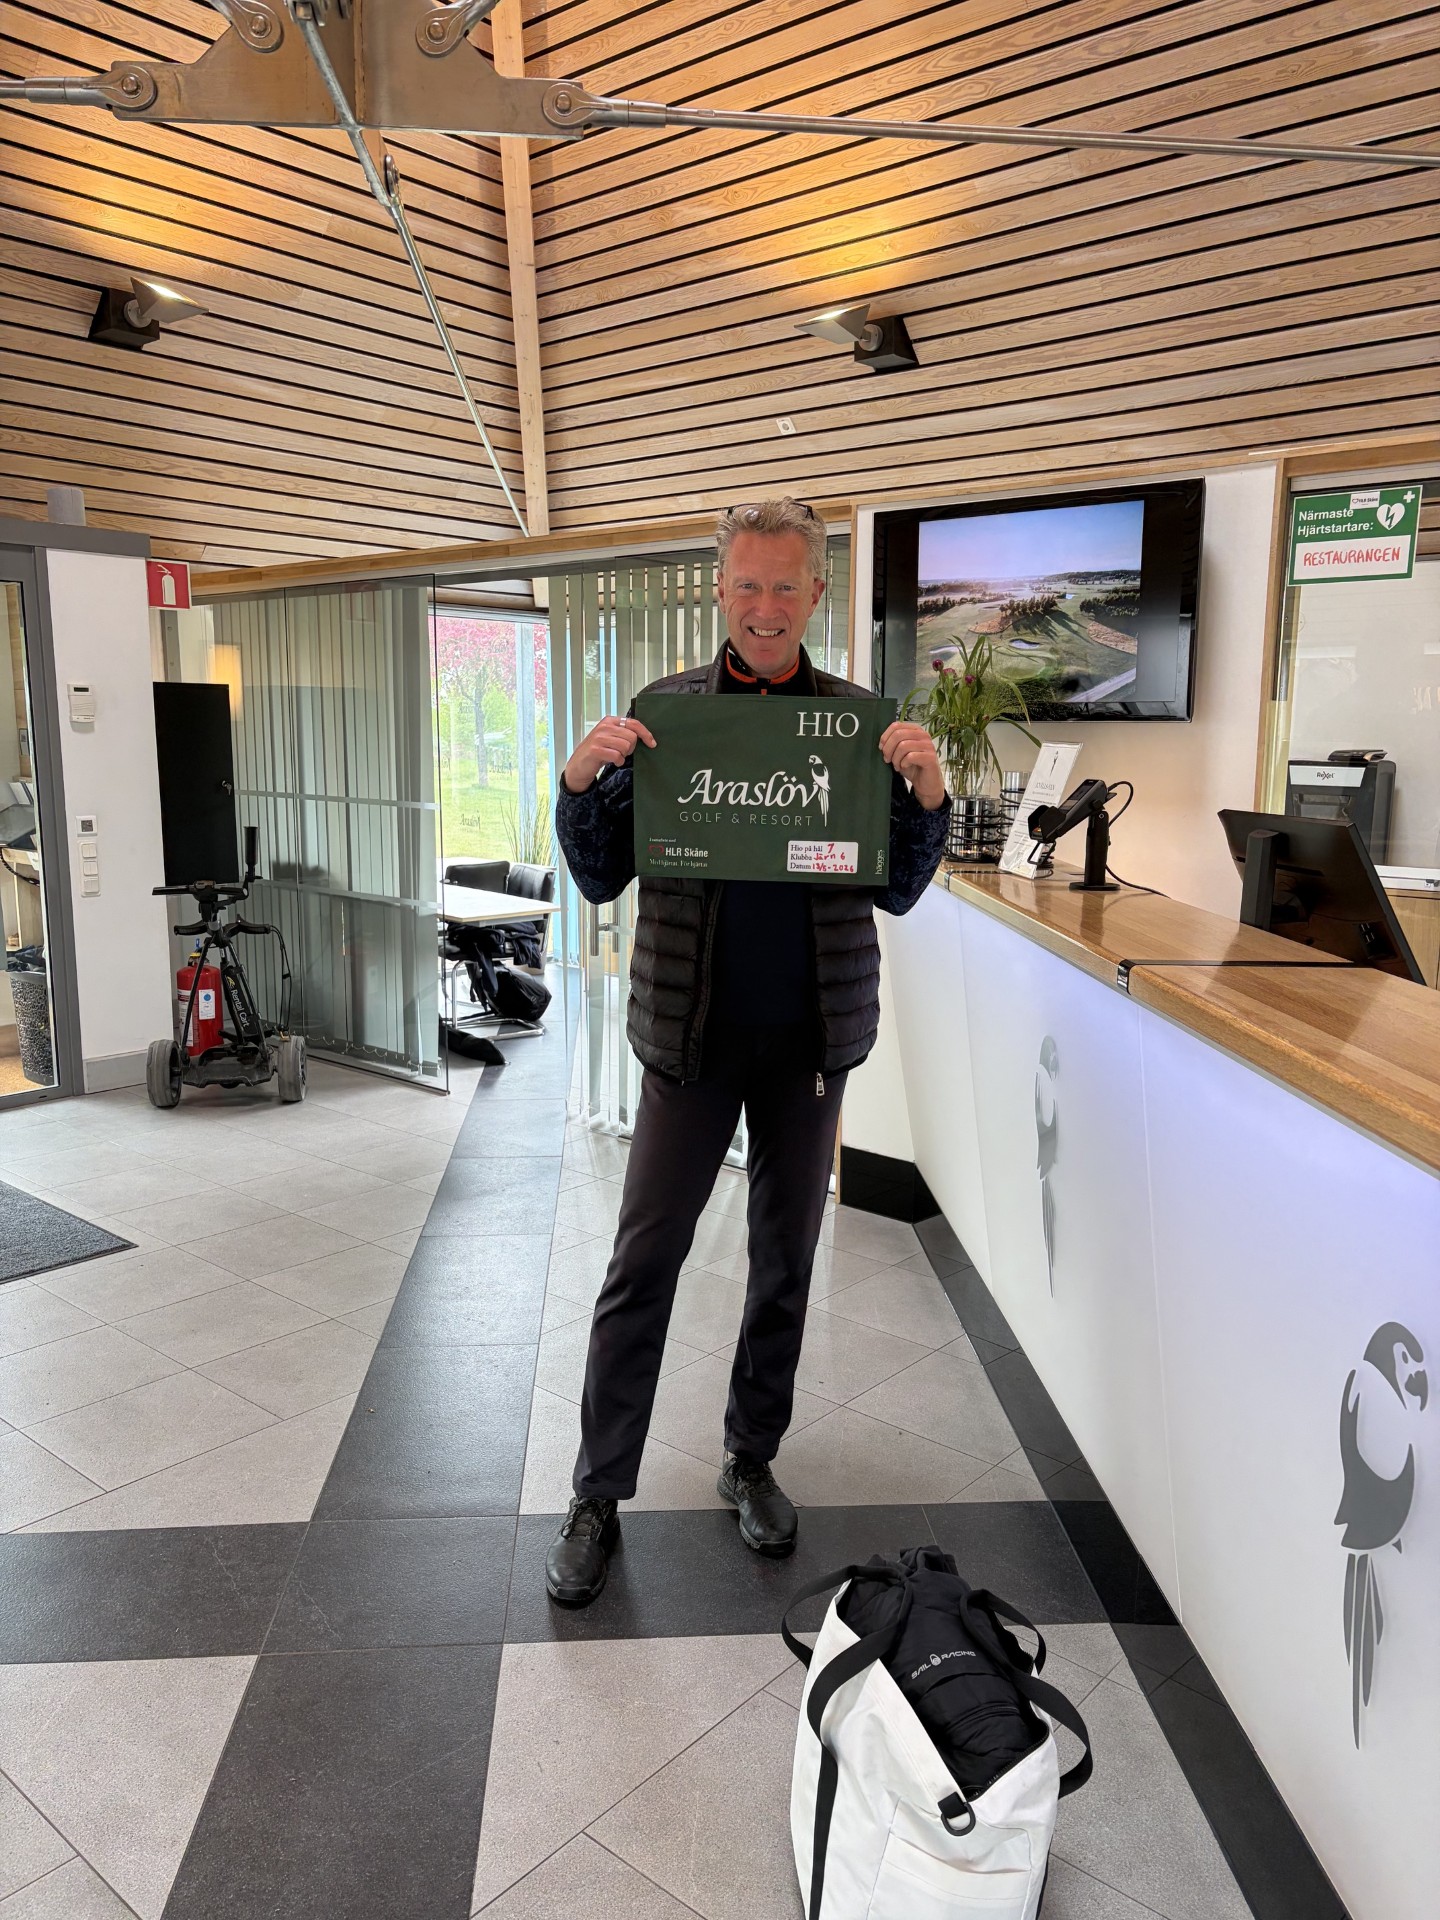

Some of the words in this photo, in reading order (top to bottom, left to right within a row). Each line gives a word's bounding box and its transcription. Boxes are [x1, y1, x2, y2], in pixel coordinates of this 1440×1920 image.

[1299, 508, 1354, 521] Närmaste
[1297, 522, 1374, 537] Hjärtstartare:
[1303, 547, 1401, 567] RESTAURANGEN
[796, 712, 860, 738] HIO
[677, 769, 819, 808] Araslöv
[679, 811, 722, 824] GOLF
[731, 813, 740, 824] &
[750, 813, 813, 827] RESORT
[665, 847, 682, 857] HLR
[684, 848, 709, 858] Skåne
[790, 844, 803, 852] Hio
[804, 845, 812, 853] på
[827, 843, 835, 854] 7
[790, 853, 813, 861] Klubba
[840, 852, 846, 860] 6
[790, 862, 812, 870] Datum
[230, 989, 245, 1012] Rental
[239, 1012, 250, 1028] Cart
[911, 1663, 931, 1679] SAIL
[940, 1651, 976, 1660] RACING
